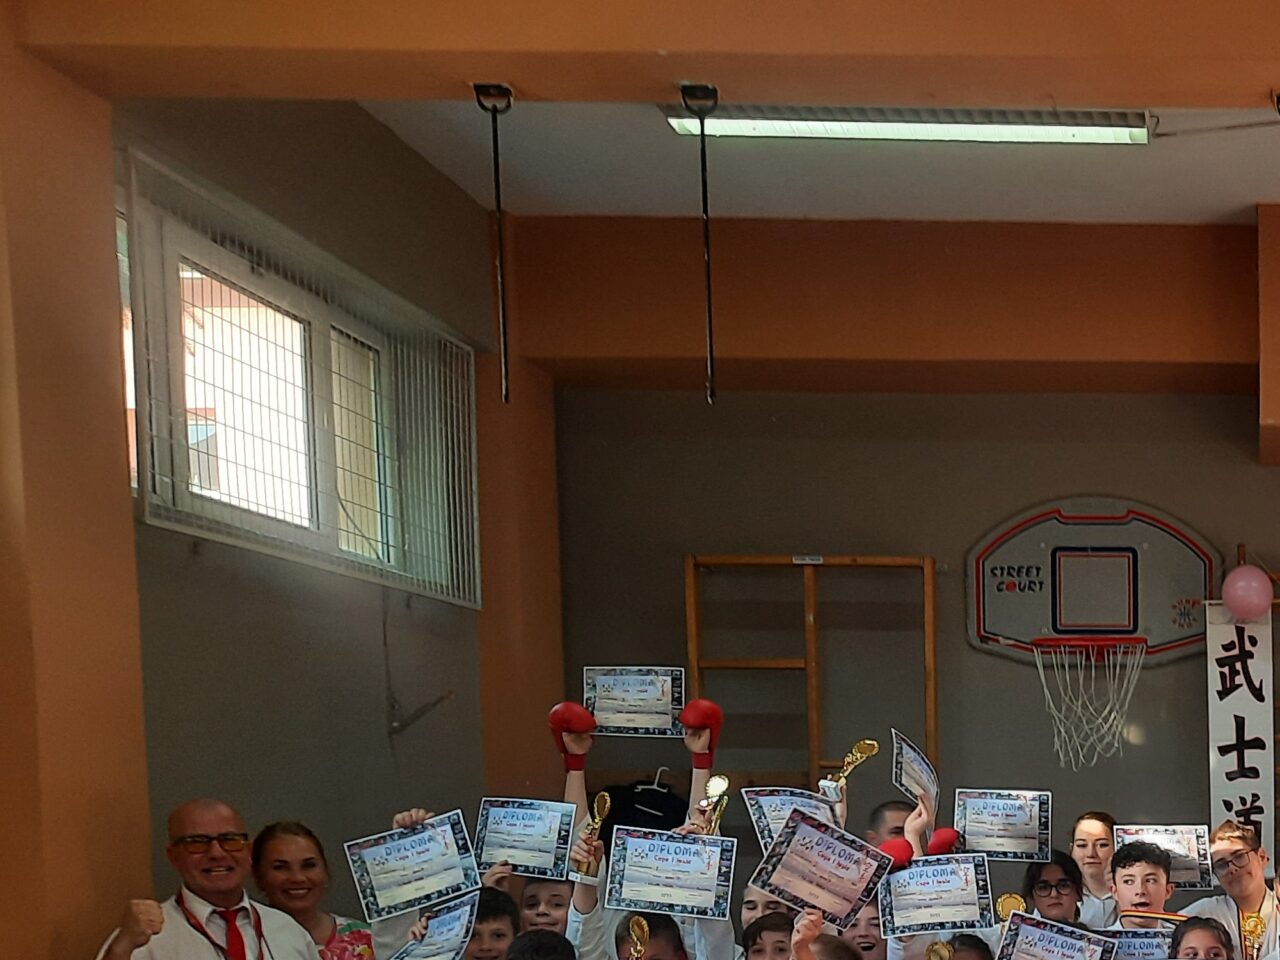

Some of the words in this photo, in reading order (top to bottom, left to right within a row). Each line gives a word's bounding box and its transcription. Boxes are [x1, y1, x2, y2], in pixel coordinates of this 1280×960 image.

[990, 565, 1042, 578] STREET
[996, 580, 1045, 593] COURT
[648, 843, 700, 857] DIPLOMA
[814, 835, 861, 865] DIPLOMA
[908, 866, 957, 881] DIPLOMA
[1037, 933, 1085, 953] DIPLOMA
[1117, 940, 1162, 950] DIPLOMA
